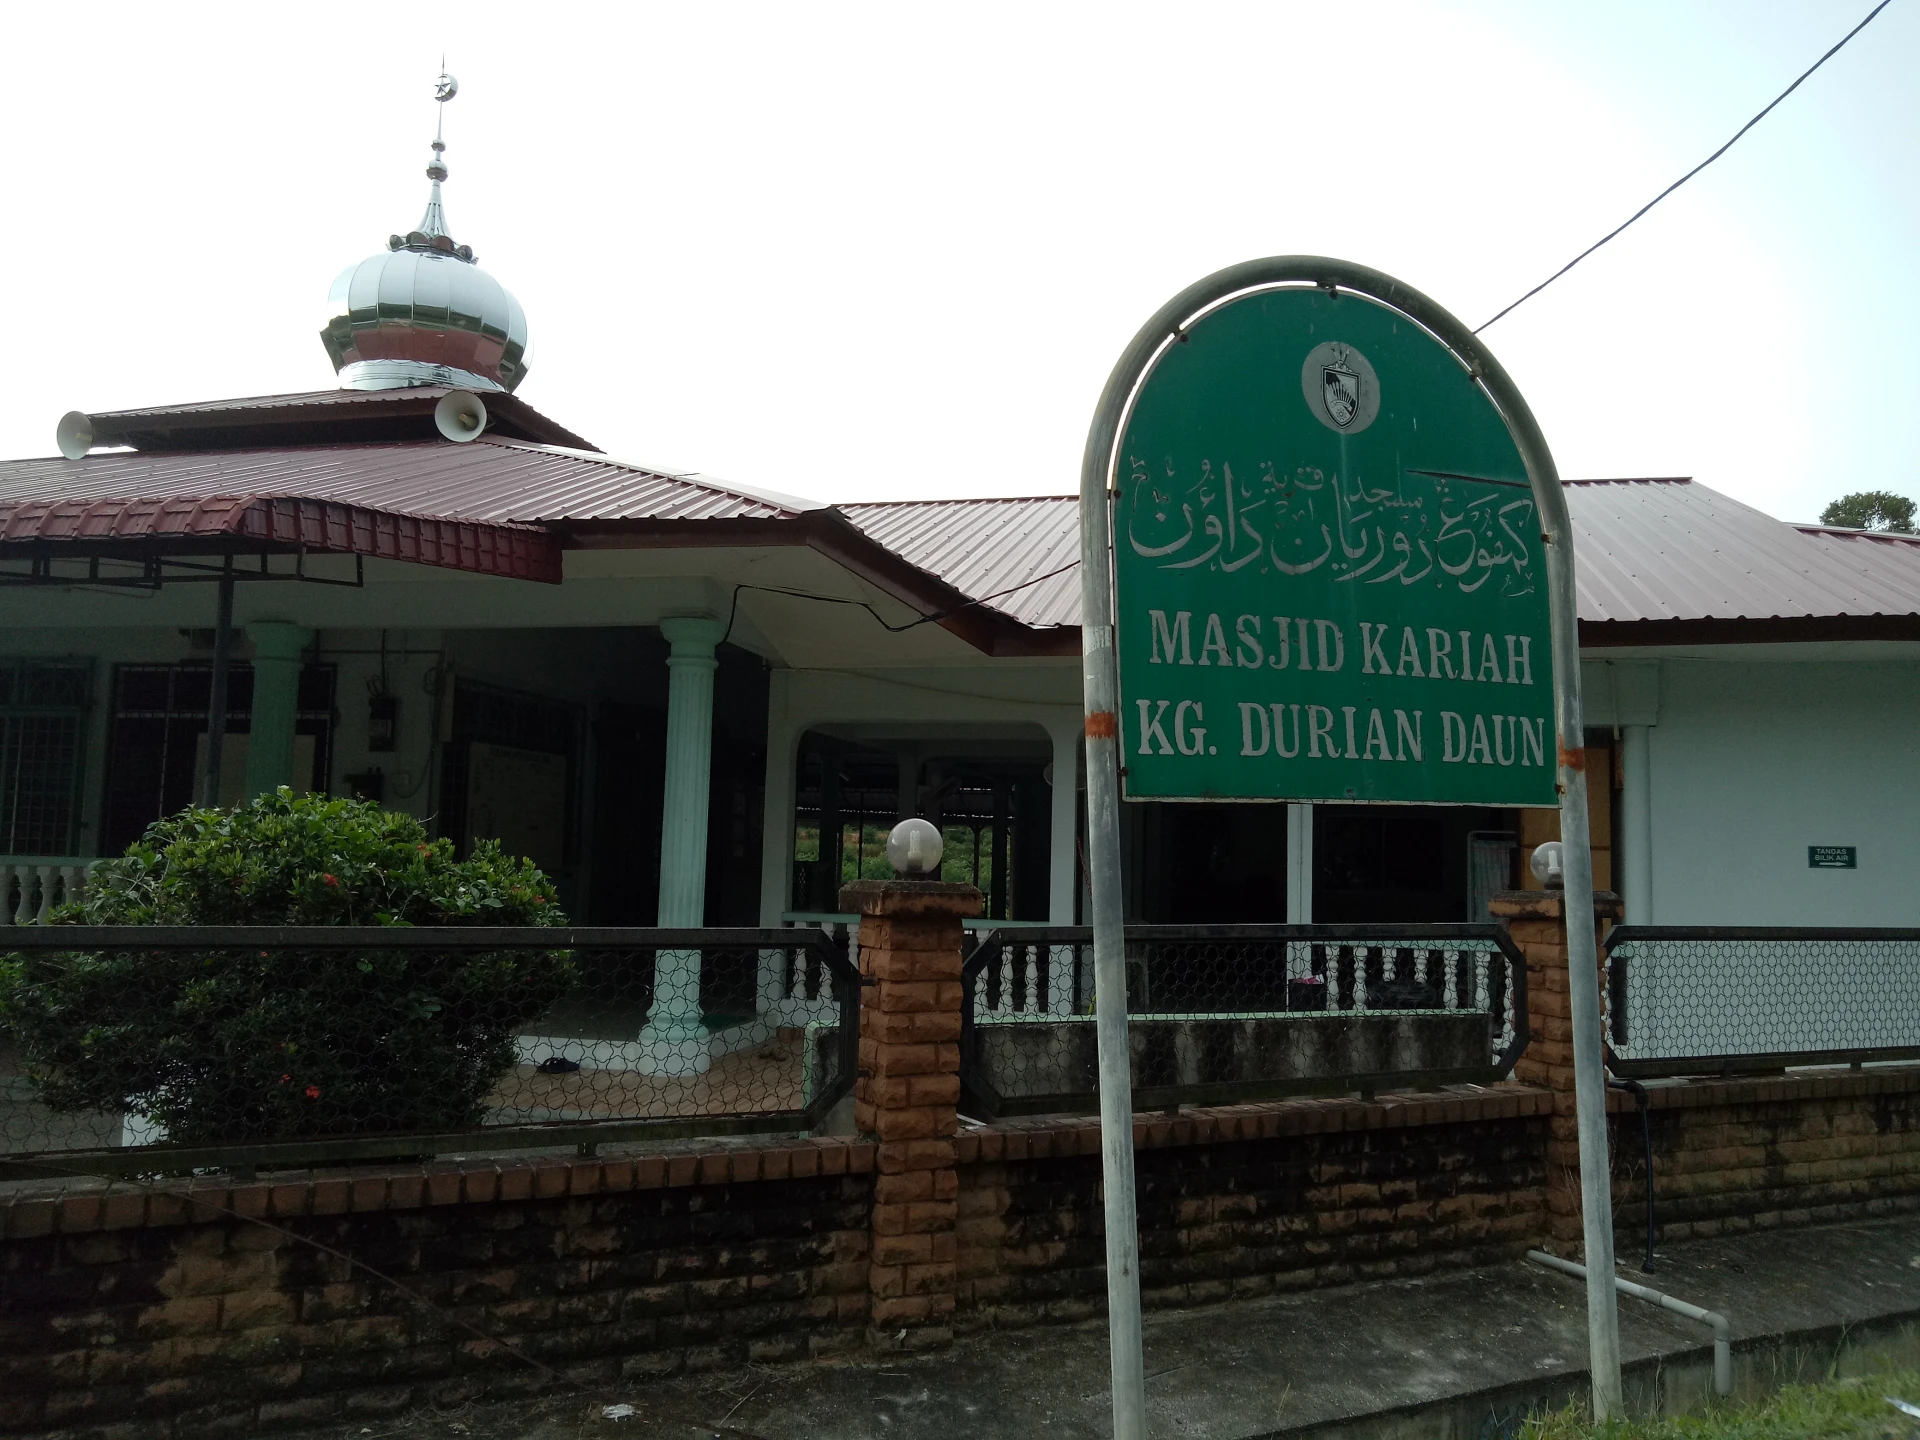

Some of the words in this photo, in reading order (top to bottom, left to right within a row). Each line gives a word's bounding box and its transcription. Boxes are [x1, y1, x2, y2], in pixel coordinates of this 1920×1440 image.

[1149, 610, 1344, 671] MASJID
[1360, 622, 1534, 685] KARIAH
[1136, 700, 1217, 756] KG.
[1238, 702, 1425, 762] DURIAN
[1441, 711, 1545, 767] DAUN
